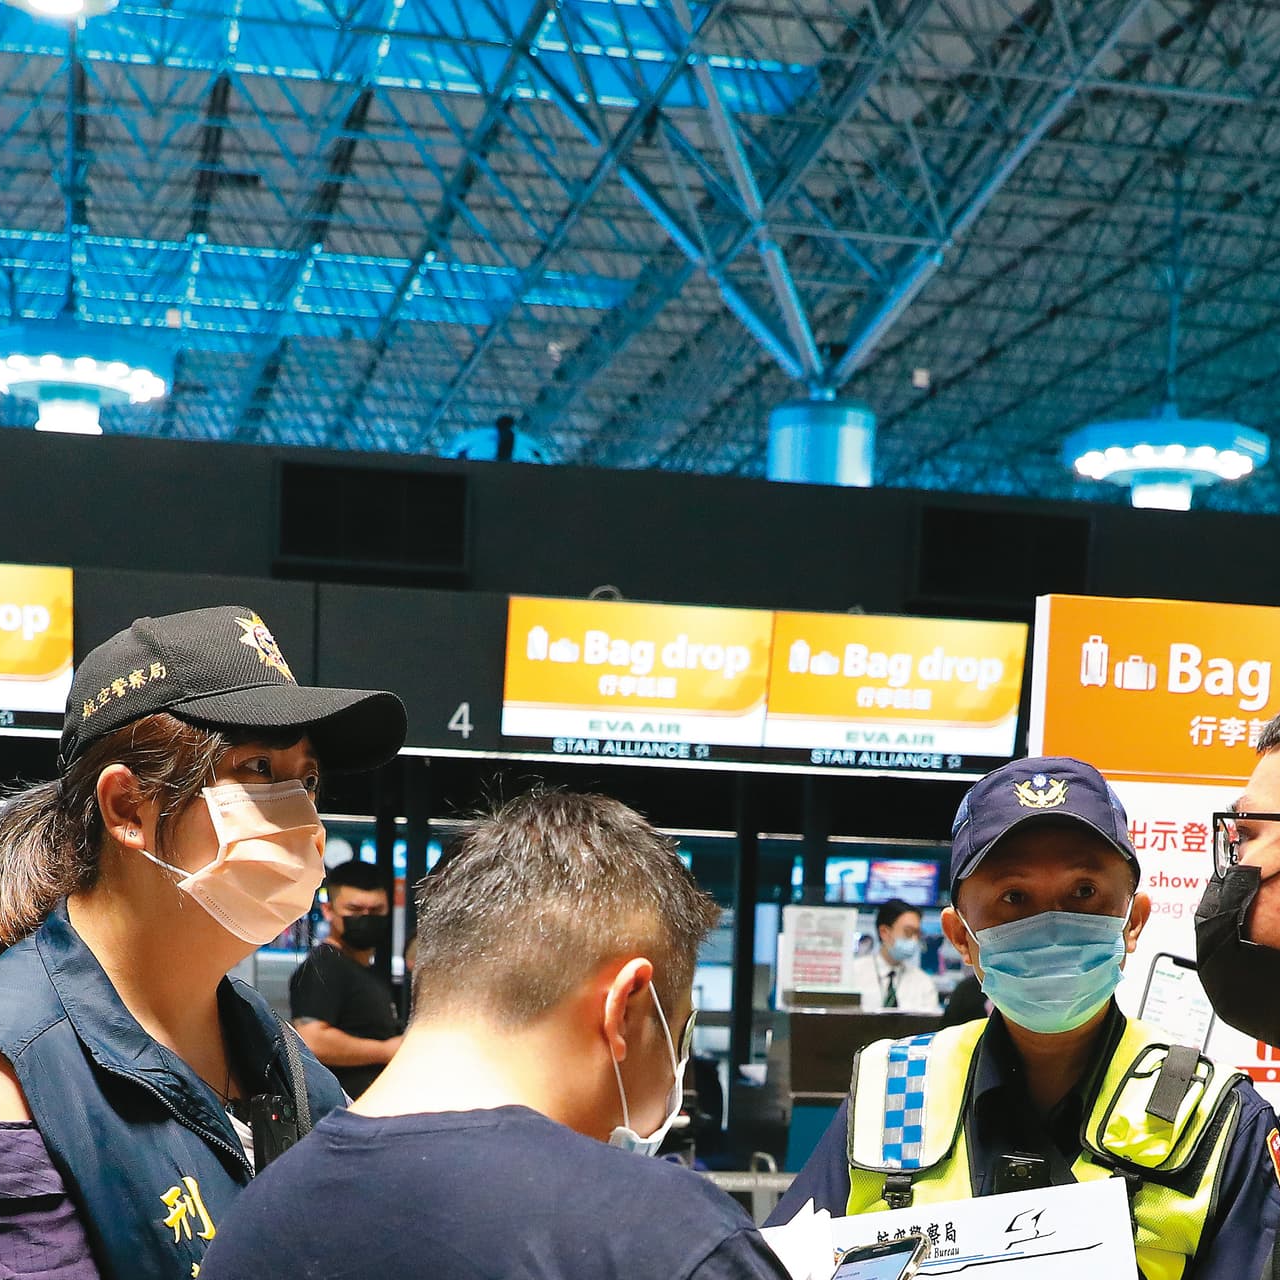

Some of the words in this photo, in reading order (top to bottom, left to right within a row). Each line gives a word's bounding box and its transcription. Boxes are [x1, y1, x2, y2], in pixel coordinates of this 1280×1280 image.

[584, 630, 655, 675] Bag
[661, 633, 750, 679] drop
[843, 643, 913, 688] Bag
[918, 647, 1004, 691] drop
[1167, 642, 1273, 711] Bag
[448, 701, 474, 739] 4
[588, 720, 634, 733] EVA
[637, 722, 682, 735] AIR
[552, 737, 600, 754] STAR
[603, 740, 690, 758] ALLIANCE
[846, 730, 891, 744] EVA
[895, 732, 935, 745] AIR
[811, 749, 856, 766] STAR
[858, 752, 942, 769] ALLIANCE
[1150, 872, 1199, 889] show
[160, 1176, 217, 1278] 刑
[934, 1246, 960, 1259] Bureau
